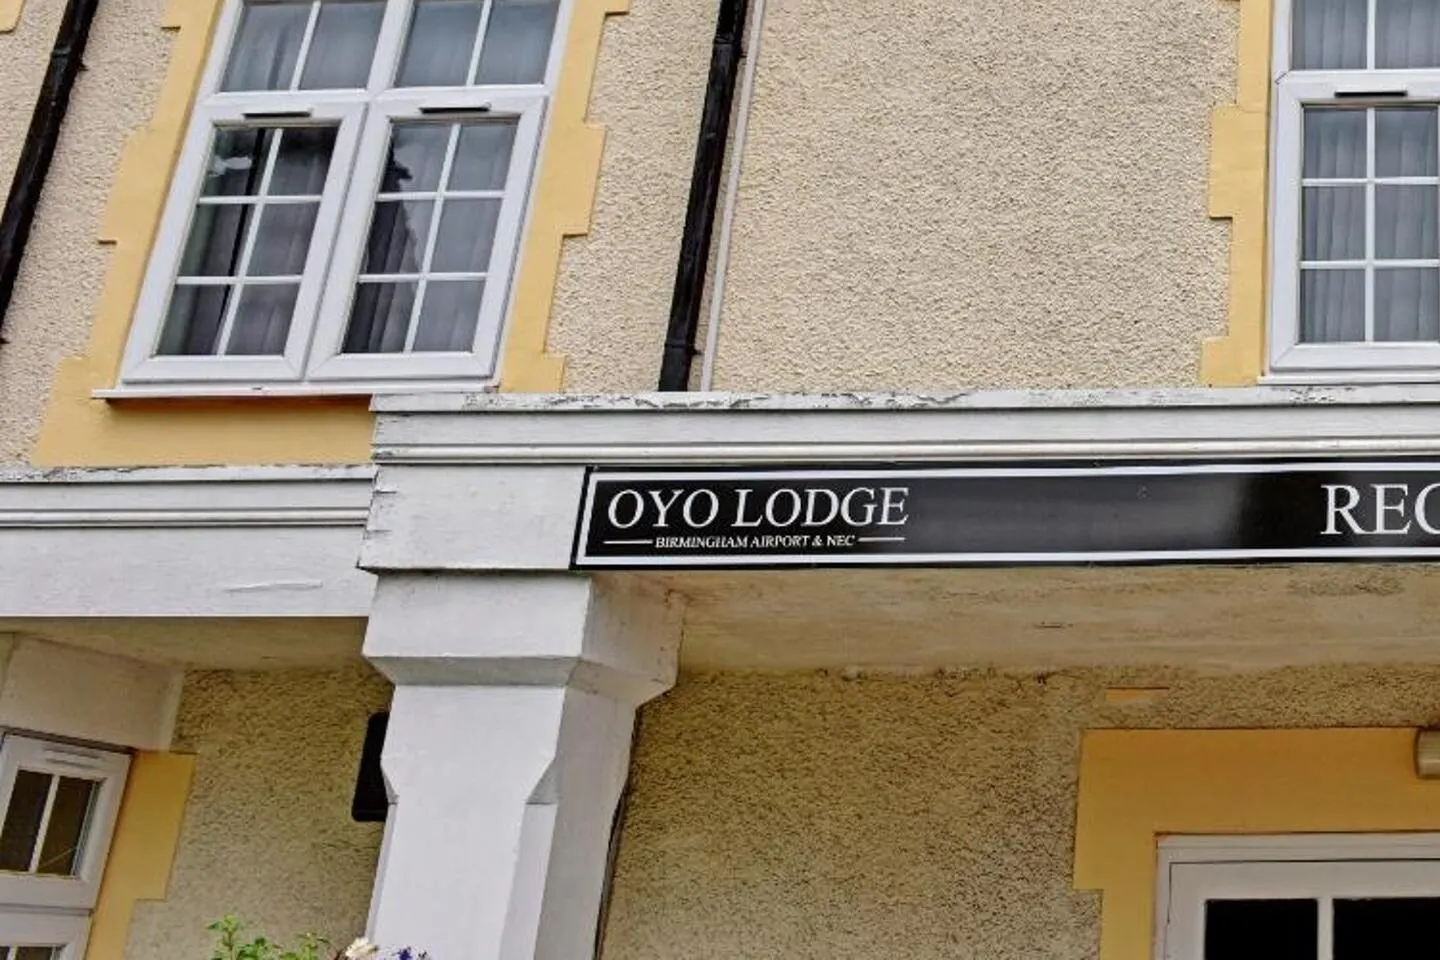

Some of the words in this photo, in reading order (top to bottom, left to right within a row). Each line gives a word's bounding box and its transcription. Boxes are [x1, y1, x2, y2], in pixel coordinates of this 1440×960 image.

[607, 489, 720, 528] OYO
[731, 487, 910, 527] LODGE
[655, 536, 748, 549] BIRMINGHAM
[750, 535, 810, 548] AIRPORT
[811, 535, 823, 547] &
[826, 534, 856, 547] NEC
